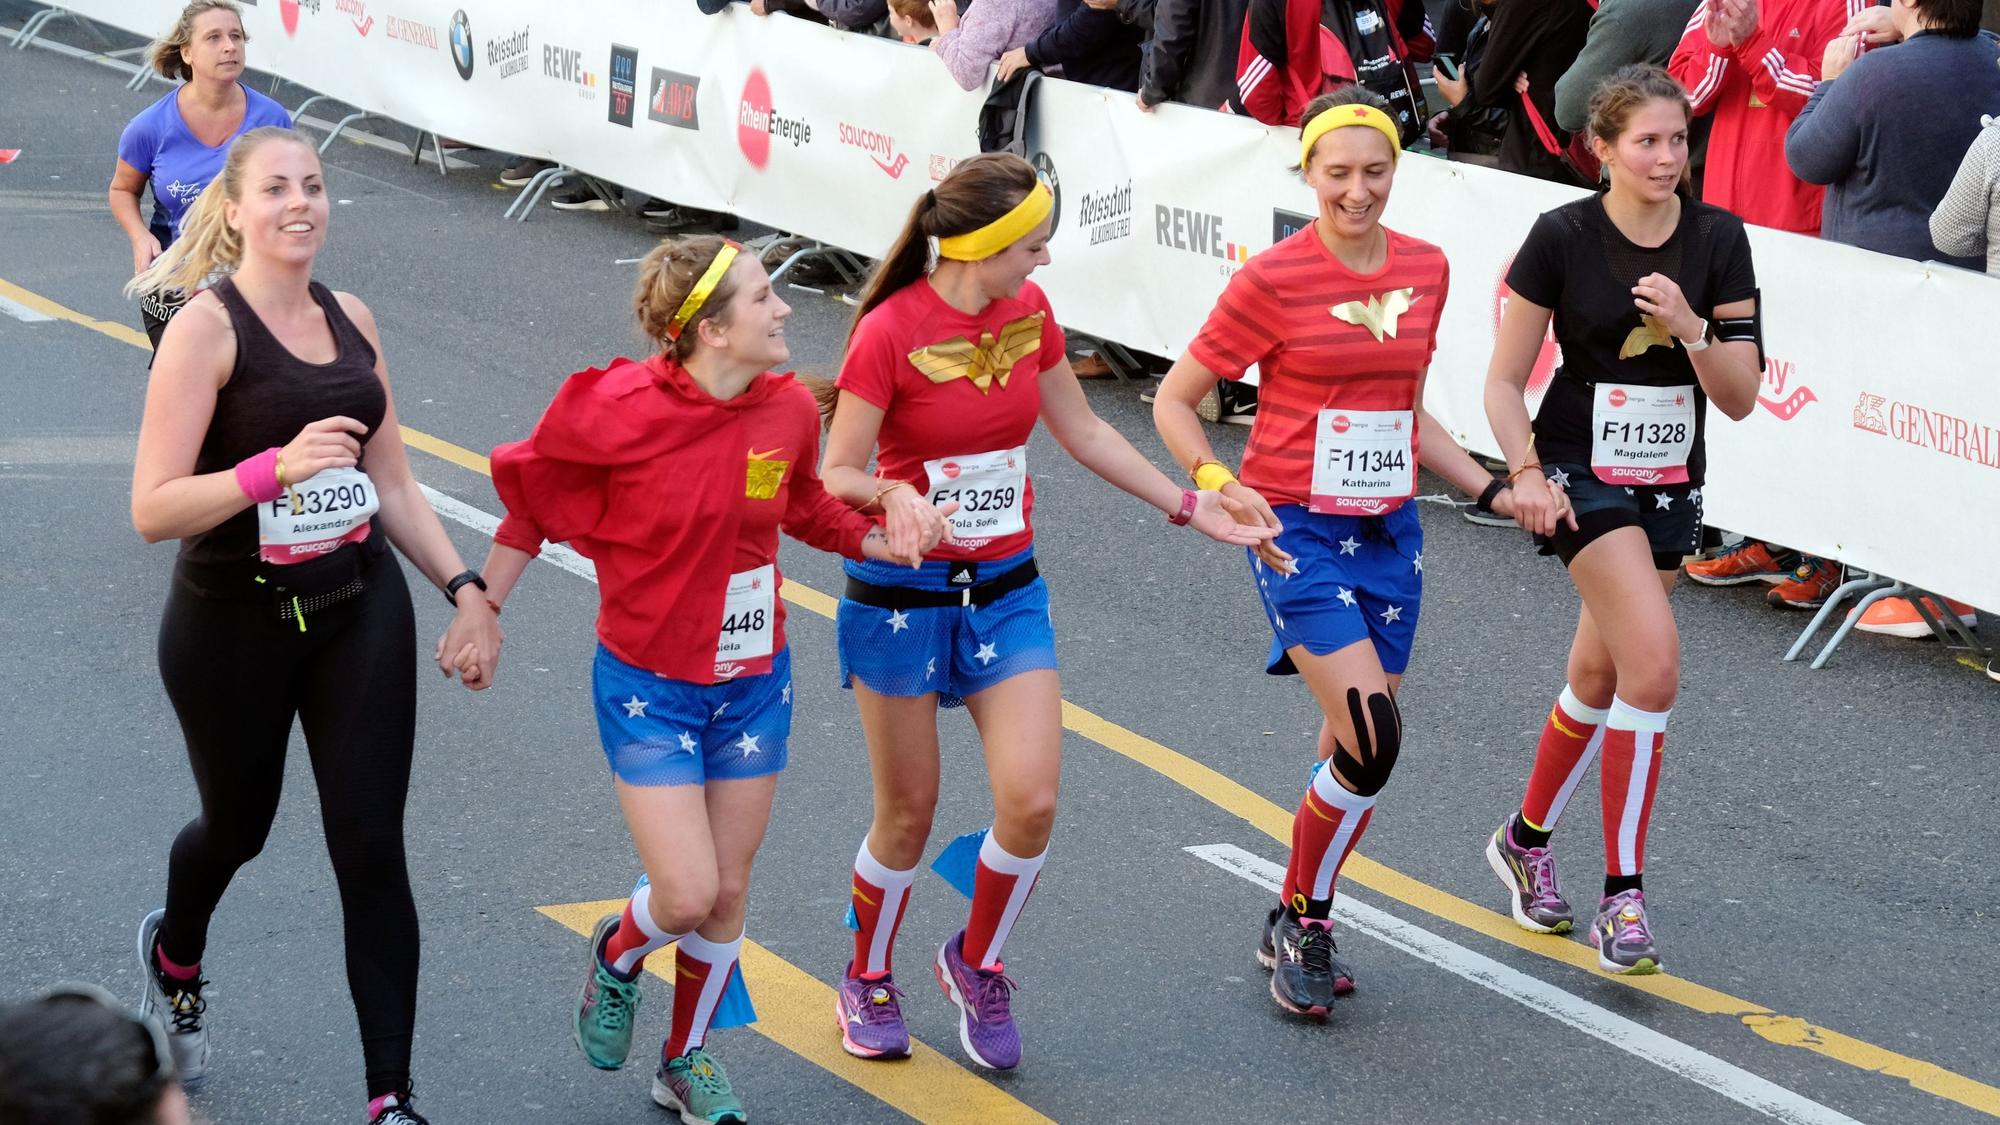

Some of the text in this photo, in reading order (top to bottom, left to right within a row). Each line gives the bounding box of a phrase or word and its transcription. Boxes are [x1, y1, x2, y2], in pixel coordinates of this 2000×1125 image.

[397, 18, 438, 50] GENERALI
[487, 24, 529, 66] Reissdorf
[544, 43, 582, 84] REWE
[741, 100, 811, 147] RheinEnergie
[839, 121, 893, 160] saucony
[1079, 177, 1132, 228] Reissdorf
[1090, 217, 1131, 247] ALKOHOLFREI
[1155, 203, 1225, 259] REWE
[1602, 421, 1686, 444] F11328
[1328, 448, 1405, 472] F11344
[1614, 448, 1668, 459] Magdalene
[1342, 478, 1391, 488] Katharina
[1611, 468, 1655, 479] saucony
[1336, 497, 1380, 508] saucony
[293, 519, 353, 534] Alexandra
[975, 517, 999, 527] Sofie
[289, 539, 338, 555] saucony
[721, 608, 765, 635] 448
